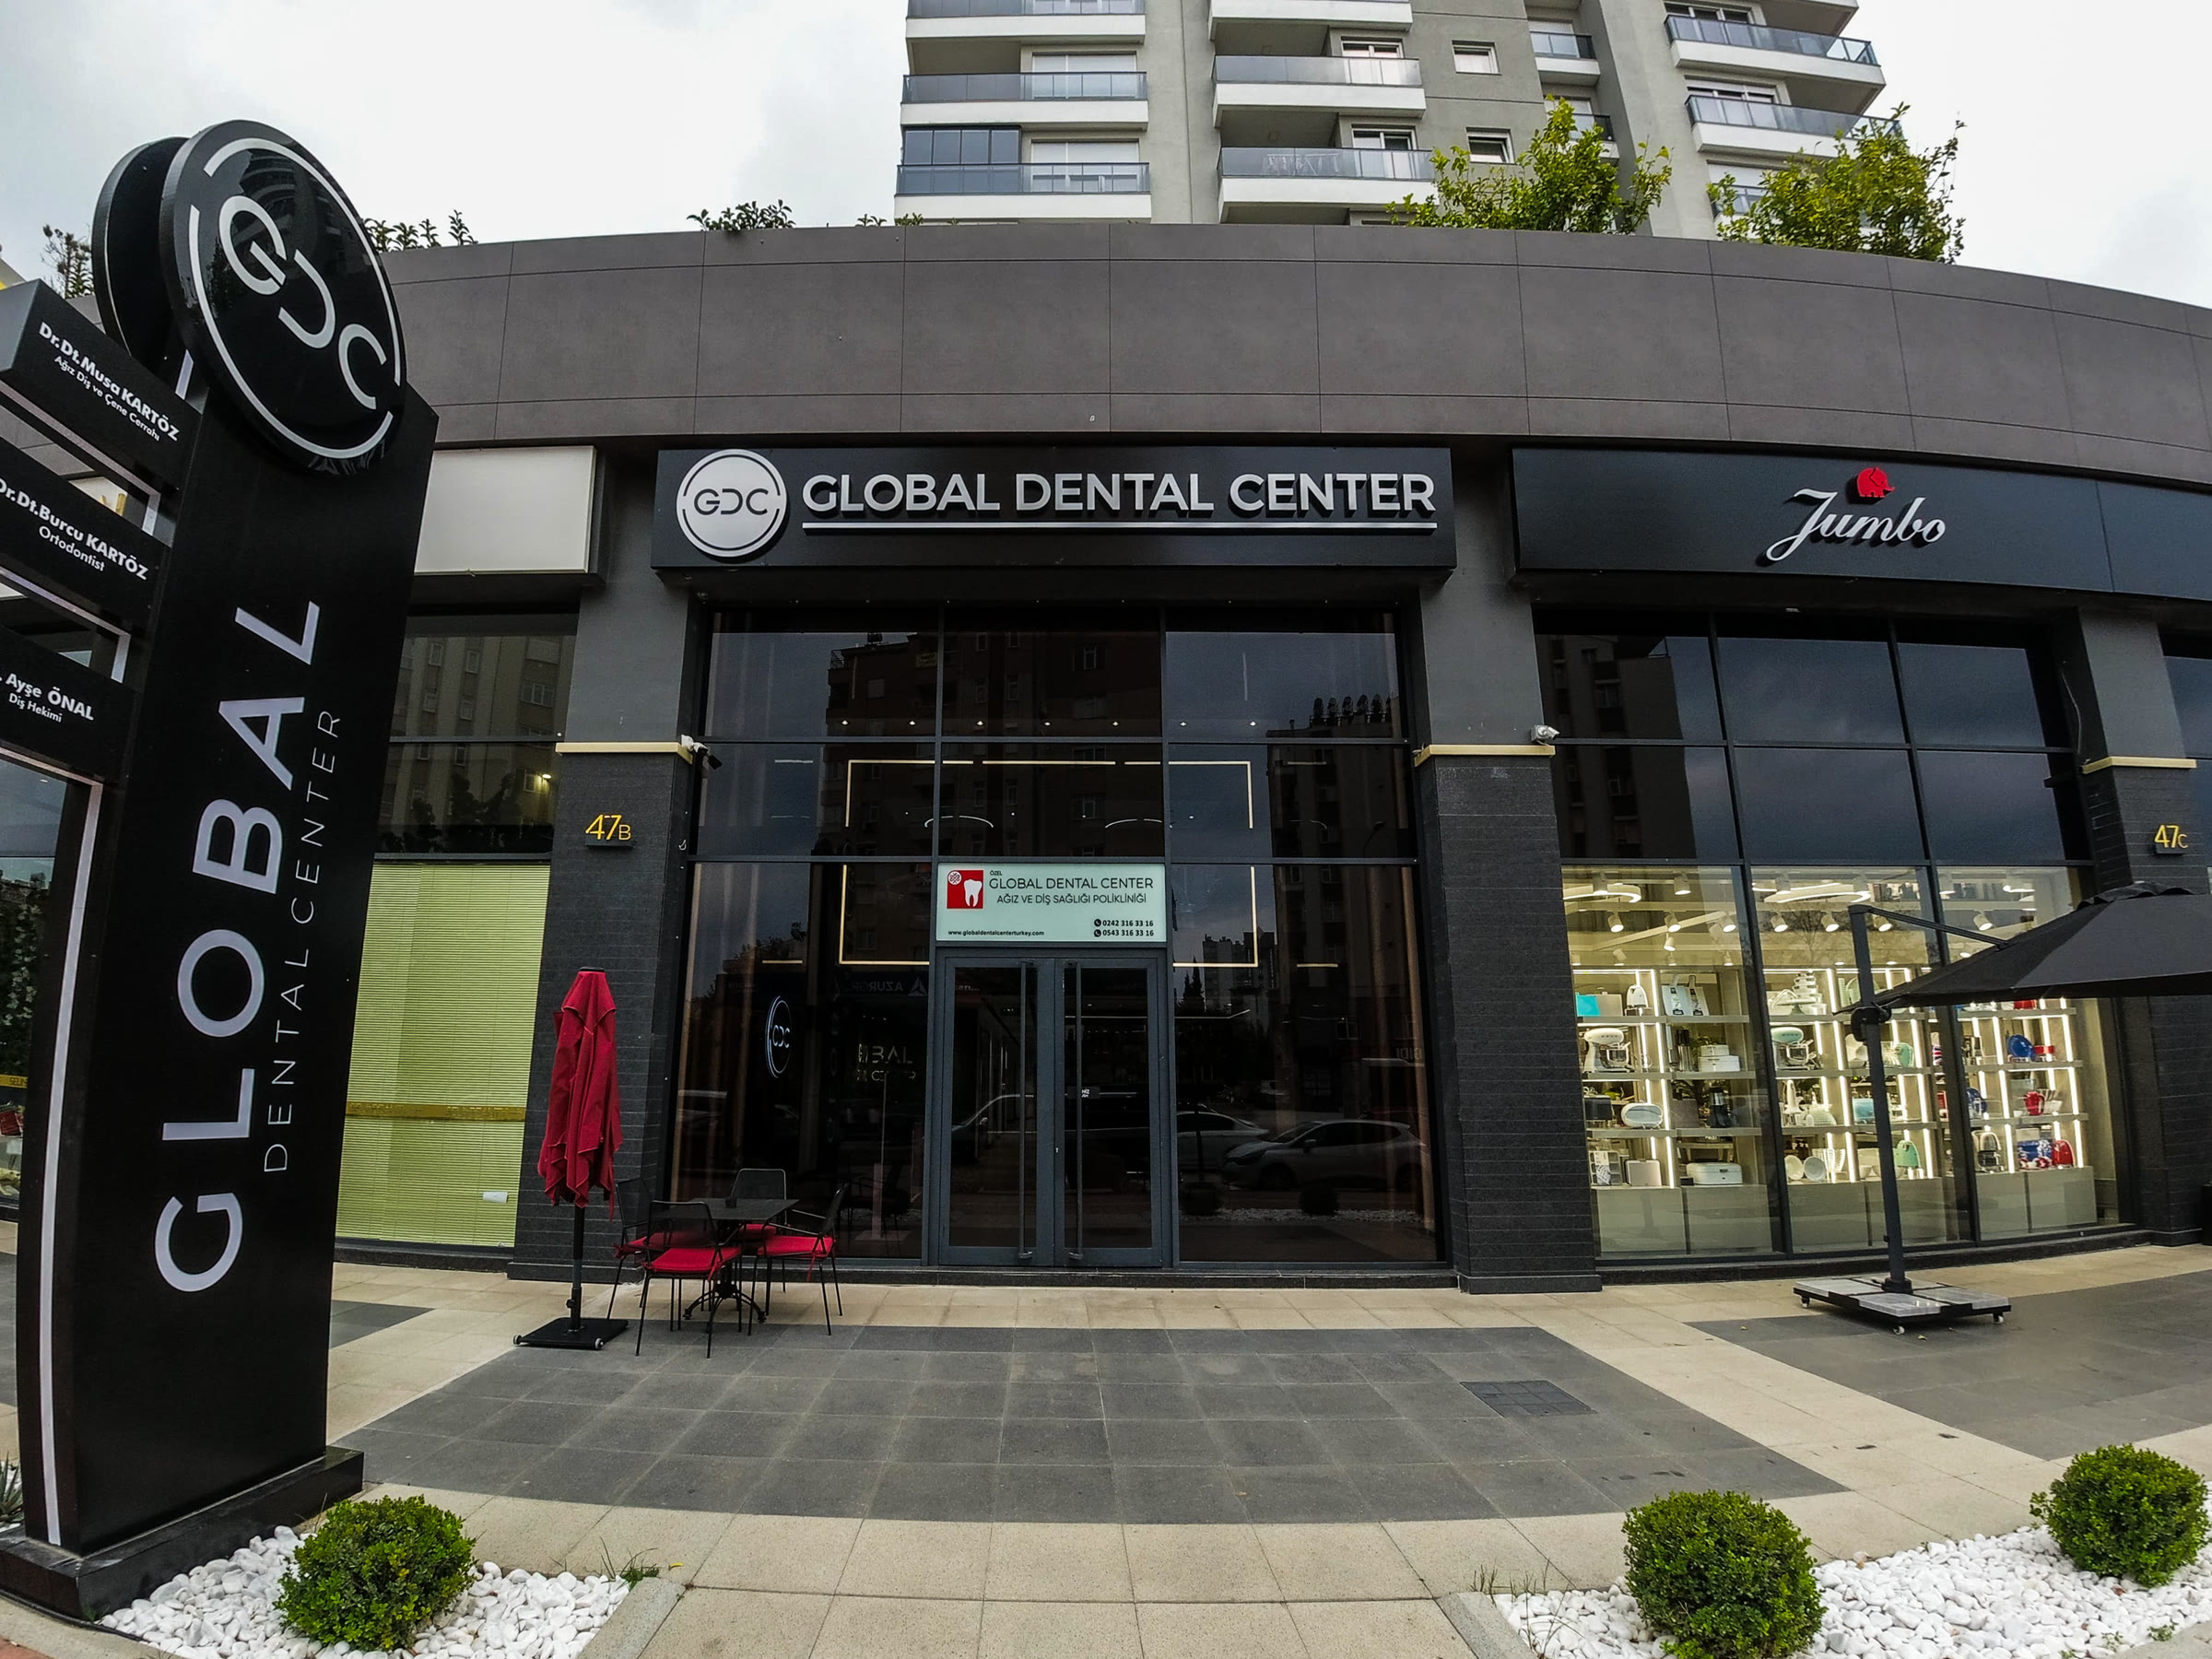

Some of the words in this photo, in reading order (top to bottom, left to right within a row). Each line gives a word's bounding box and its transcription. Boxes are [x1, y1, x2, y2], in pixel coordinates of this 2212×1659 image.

[53, 355, 76, 376] Ağız
[76, 371, 91, 390] Diş
[92, 384, 104, 397] ve
[104, 394, 128, 417] Çene
[129, 412, 160, 442] Cerrahı
[121, 387, 181, 442] KARTÖZ
[694, 488, 769, 516] GDC
[802, 473, 1001, 512] GLOBAL
[1016, 472, 1215, 512] DENTAL
[1230, 472, 1436, 512] CENTER
[39, 525, 105, 571] Ortodontist
[1765, 488, 1947, 561] Jumbo
[86, 533, 149, 581] KARTÖZ
[5, 673, 42, 698] Ayşe
[47, 686, 95, 721] ÖNAL
[8, 692, 26, 710] Diş
[27, 700, 64, 723] Hekimi
[584, 814, 631, 841] 47B
[989, 877, 1043, 889] GLOBAL
[1046, 877, 1099, 889] DENTAL
[1100, 877, 1154, 889] CENTER
[996, 893, 1019, 903] AĞIZ
[1021, 894, 1033, 903] VE
[1035, 892, 1052, 906] DİŞ
[1053, 893, 1091, 904] SAĞLIĞI
[1093, 892, 1147, 903] POLİKLİNİĞİ
[154, 600, 321, 1293] GLOBAL
[264, 947, 310, 1173] DENTAL
[290, 710, 341, 924] CENTER
